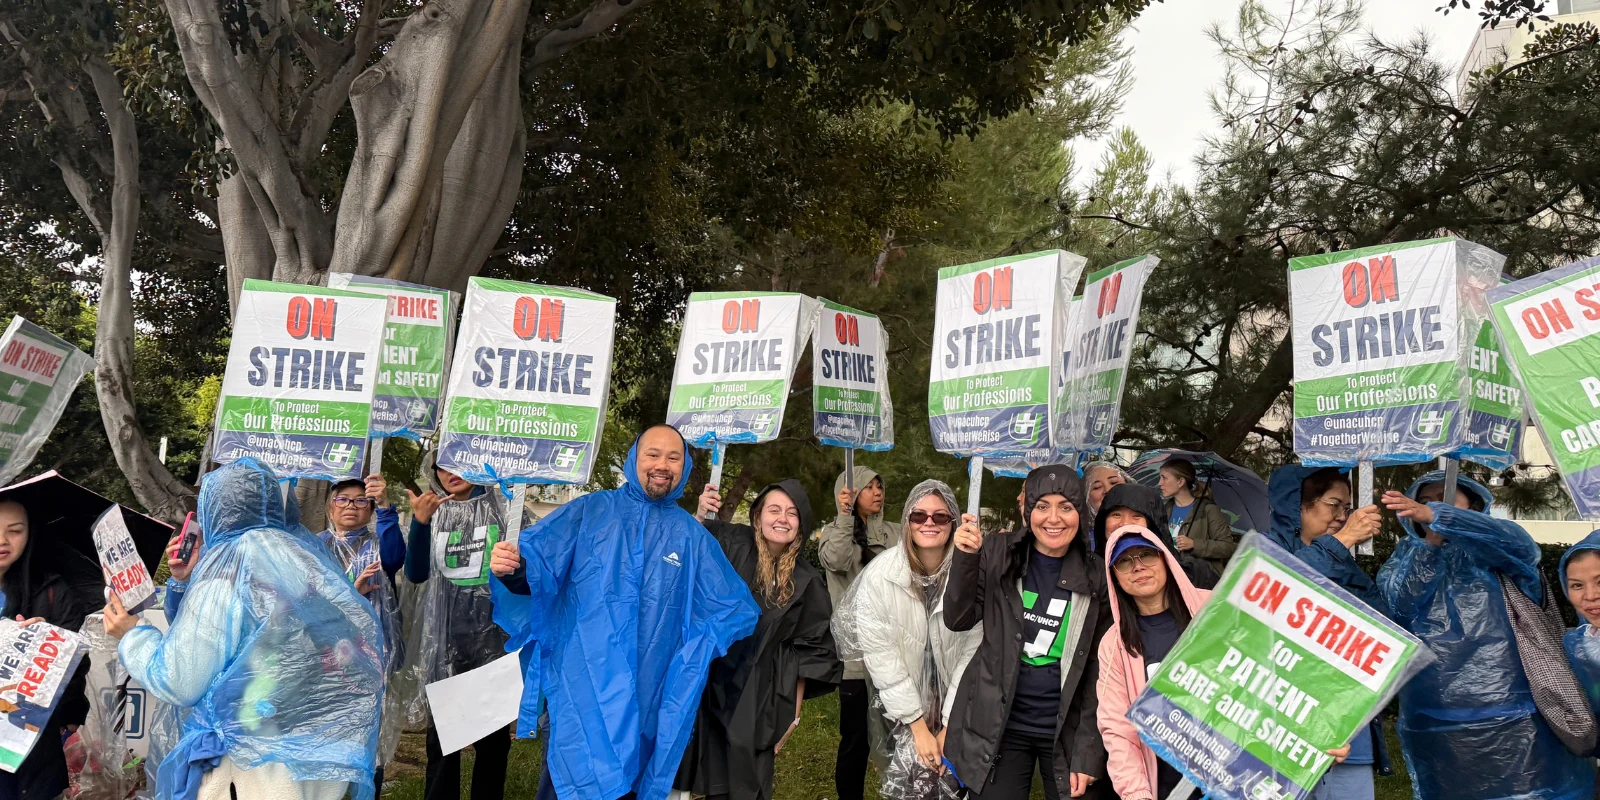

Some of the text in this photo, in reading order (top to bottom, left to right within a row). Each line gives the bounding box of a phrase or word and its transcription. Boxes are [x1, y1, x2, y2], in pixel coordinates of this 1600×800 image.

[973, 266, 1014, 315] ON
[1097, 272, 1122, 320] ON
[1342, 255, 1399, 308] ON
[286, 295, 338, 342] ON
[388, 295, 438, 320] TRIKE
[513, 296, 565, 343] ON
[722, 298, 761, 334] ON
[1521, 298, 1574, 340] ON
[835, 312, 859, 347] ON
[945, 314, 1040, 370] STRIKE
[1312, 305, 1444, 367] STRIKE
[3, 339, 62, 378] ON STRIKE
[247, 345, 366, 392] STRIKE
[384, 345, 418, 366] IENT
[472, 346, 594, 396] STRIKE
[692, 338, 782, 376] STRIKE
[821, 348, 876, 384] STRIKE
[394, 370, 440, 388] SAFETY
[712, 382, 747, 393] To Protect
[966, 375, 1003, 390] To Protect
[1347, 372, 1397, 388] To Protect
[1476, 379, 1520, 407] SAFETY
[275, 401, 319, 414] To Protect
[501, 403, 546, 416] To Protect
[689, 392, 772, 408] Our Professions
[824, 398, 874, 413] Our Professions
[944, 386, 1032, 410] Our Professions
[1316, 384, 1438, 412] Our Professions
[243, 412, 350, 433] Our Professions
[468, 414, 578, 438] Our Professions
[1560, 419, 1600, 453] CAR
[454, 450, 539, 472] #TogetherWeRise
[471, 438, 528, 455] @unacuhcp
[105, 546, 119, 566] WE
[117, 537, 134, 558] ARE
[112, 561, 148, 594] READY
[1024, 612, 1060, 628] AC/UHCP
[1243, 570, 1390, 677] ON STRIKE
[0, 624, 40, 681] WE ARE
[17, 629, 66, 698] READY
[1267, 639, 1303, 673] for
[1216, 646, 1320, 725] PATIENT
[1168, 661, 1330, 775] CARE and SAFETY
[1168, 709, 1231, 761] @unacuhcp
[1144, 713, 1234, 786] #TogetherWeRise
